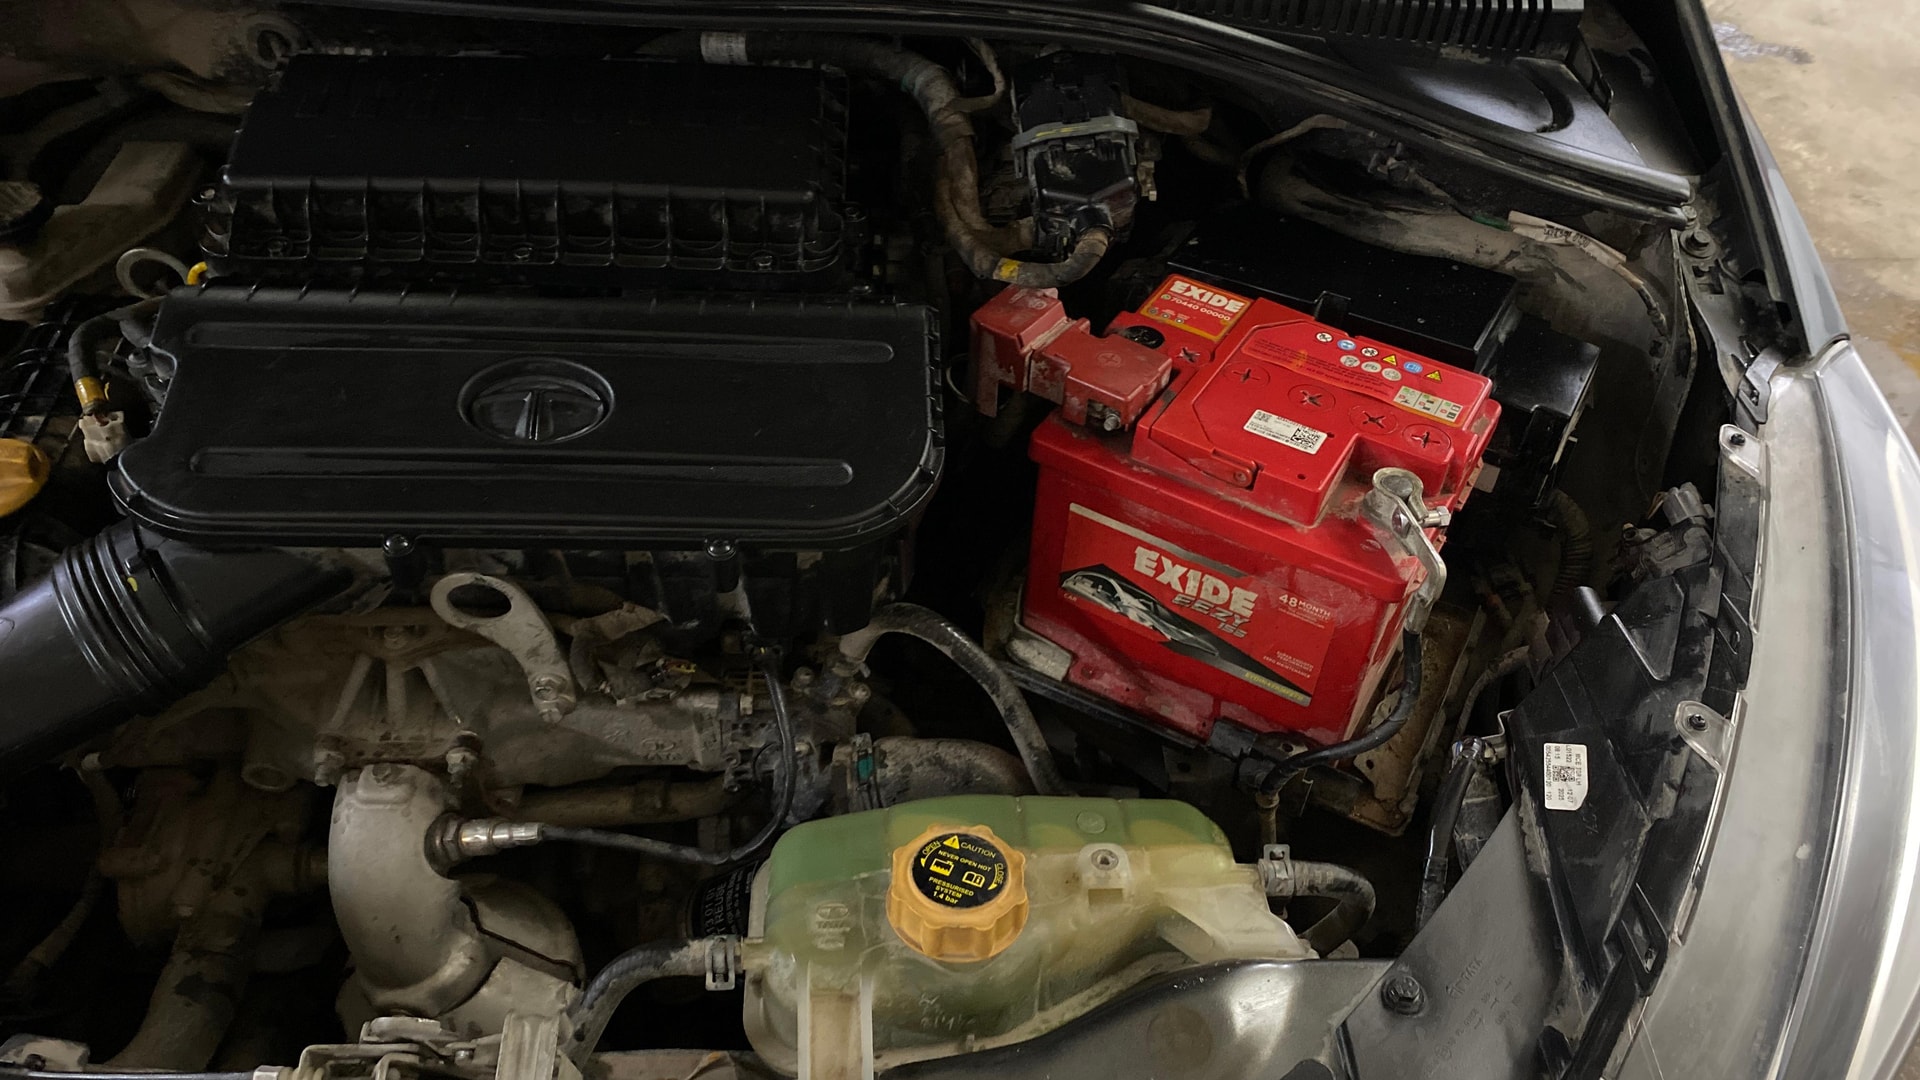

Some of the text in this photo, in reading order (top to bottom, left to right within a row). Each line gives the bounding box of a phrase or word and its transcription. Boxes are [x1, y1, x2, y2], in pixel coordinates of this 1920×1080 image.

[1170, 280, 1245, 313] EXIDE
[1170, 297, 1200, 311] 70440
[1200, 307, 1231, 321] 00000
[1133, 546, 1258, 619] EXIDE
[1171, 593, 1252, 627] EEZY
[1279, 594, 1331, 617] 48 MONTH
[922, 840, 942, 856] OPEN
[960, 841, 996, 859] CAUTION
[938, 849, 992, 872] NEVER OPEN HOT
[928, 876, 975, 897] PRESSURISED
[932, 891, 959, 904] 1.4 bar
[934, 885, 963, 899] SYSTEM
